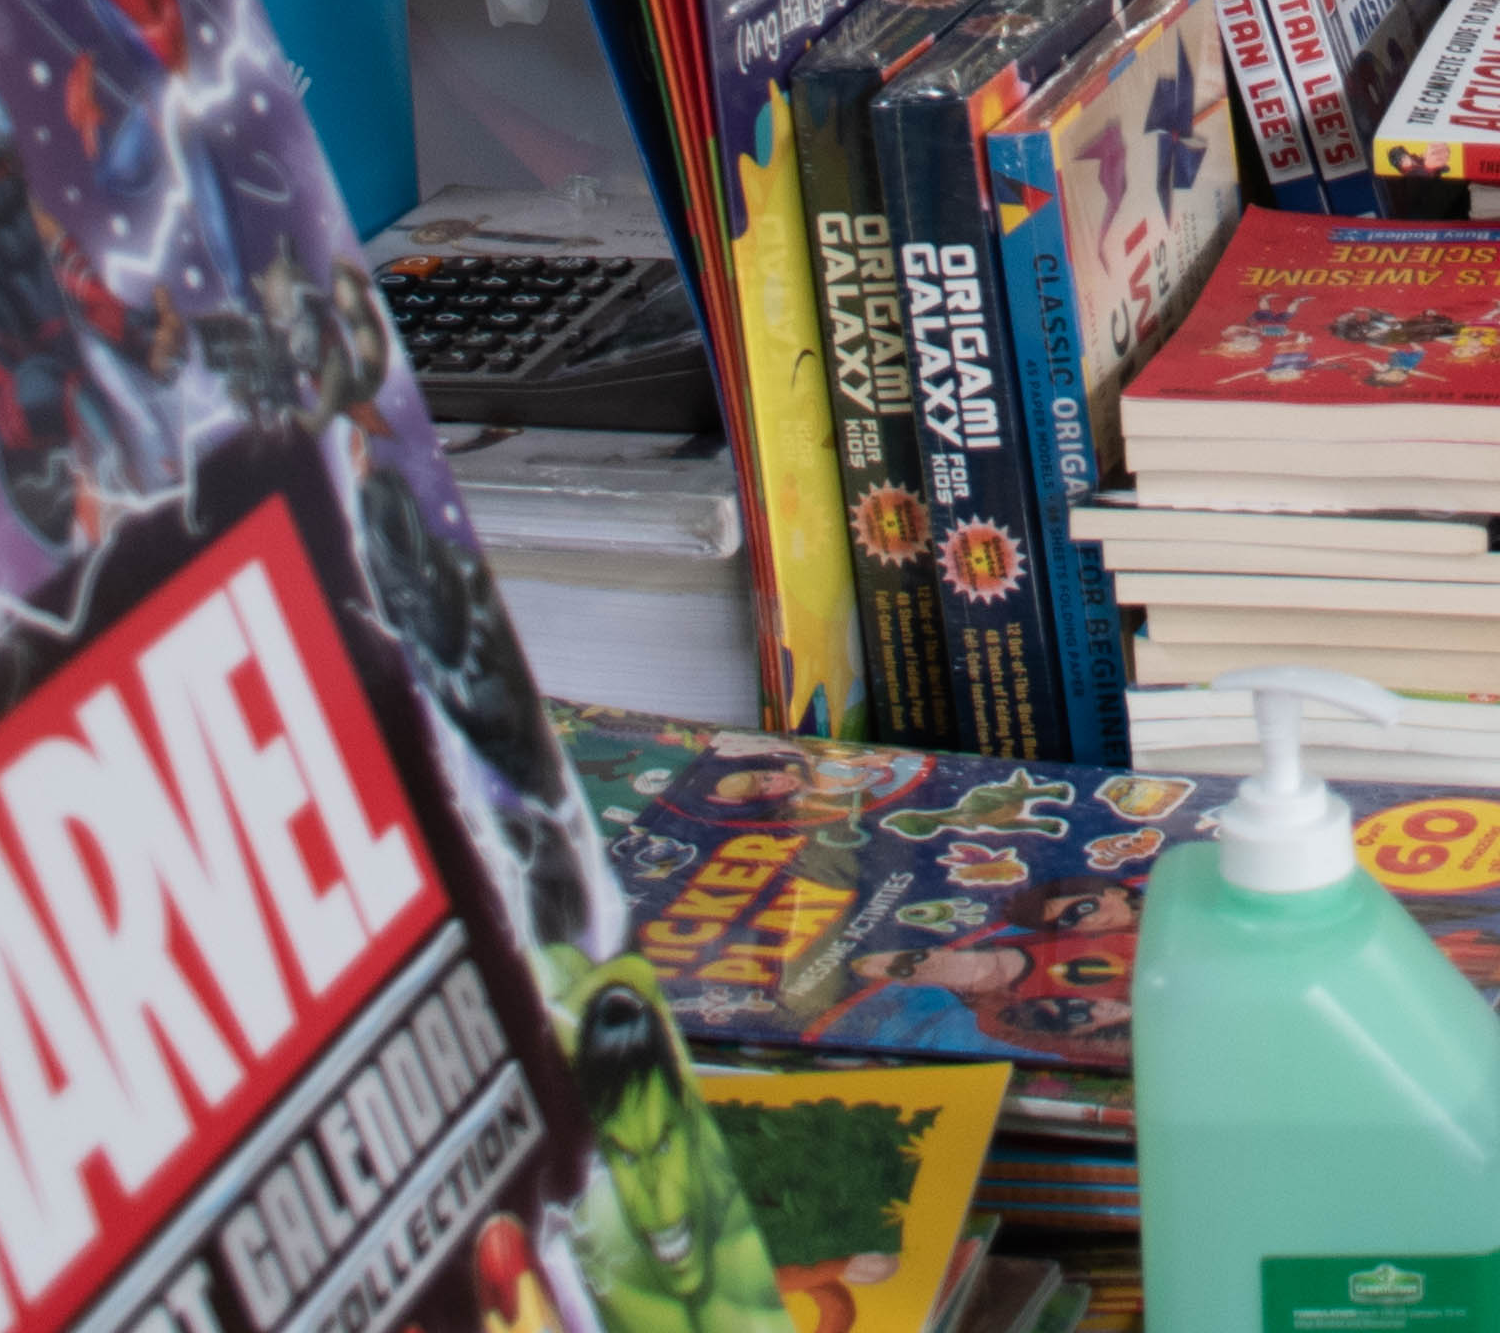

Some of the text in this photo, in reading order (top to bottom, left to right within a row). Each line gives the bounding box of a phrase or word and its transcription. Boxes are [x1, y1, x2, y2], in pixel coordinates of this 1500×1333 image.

[735, 9, 781, 76] (Ang
[1247, 77, 1301, 171] LEE'S
[1302, 72, 1356, 167] LEE'S
[1238, 265, 1443, 287] AWESOME
[1327, 244, 1498, 264] SCIENCE
[816, 211, 876, 415] GALAXY
[854, 214, 911, 415] ORIGAMI
[901, 242, 962, 449] GALAXY
[940, 243, 1001, 450] ORIGAMI
[1028, 381, 1045, 428] PAPER
[1032, 253, 1109, 606] CLASSIC FOR
[844, 418, 865, 470] KIDS
[860, 418, 882, 468] FOR
[1033, 433, 1054, 491] MODELS
[932, 453, 953, 505] KIDS
[948, 453, 971, 503] FOR
[1049, 529, 1068, 580] SHEETS
[1056, 583, 1076, 648] FOLDING
[1066, 651, 1086, 698] PAPER
[1374, 807, 1478, 876] 60
[693, 876, 858, 985] PLAY
[844, 871, 915, 941] ACTIVITIES
[219, 959, 509, 1333] CALENDAR
